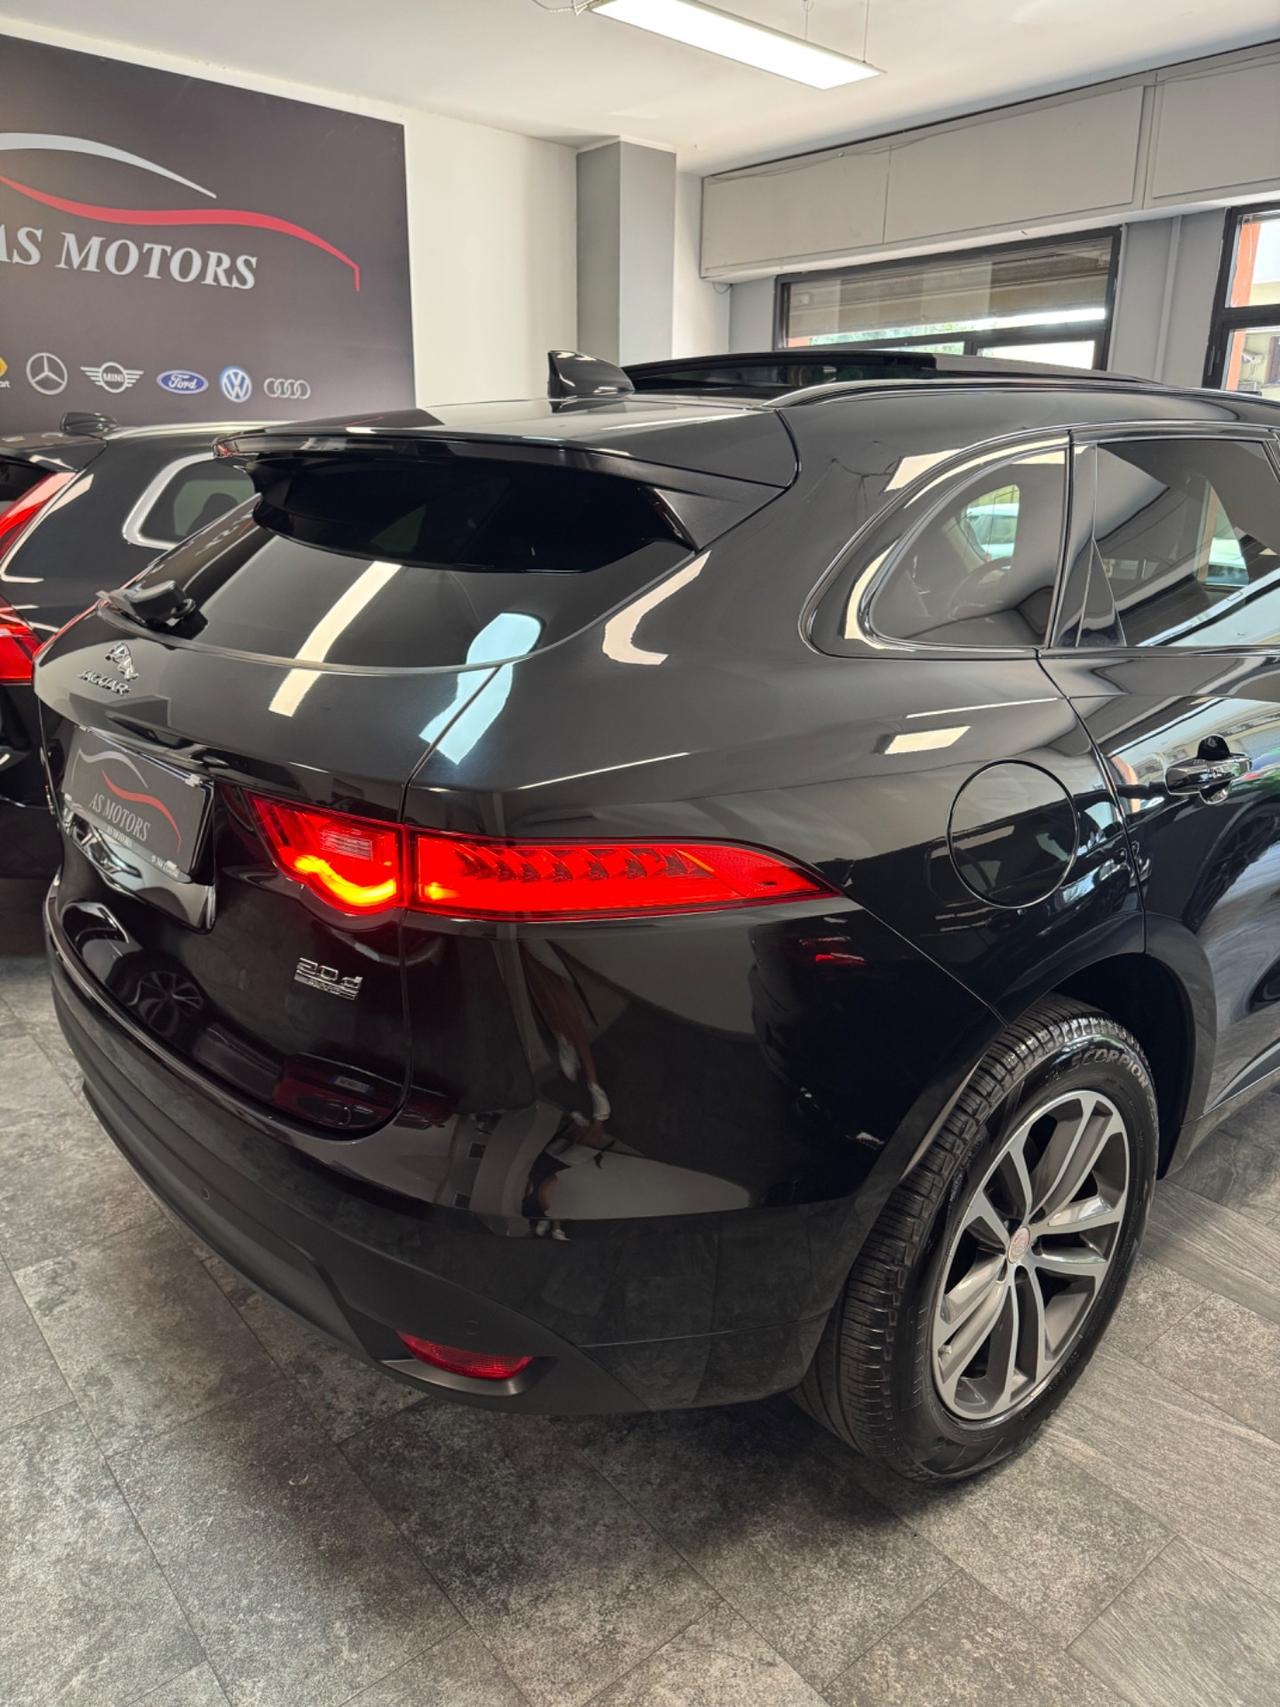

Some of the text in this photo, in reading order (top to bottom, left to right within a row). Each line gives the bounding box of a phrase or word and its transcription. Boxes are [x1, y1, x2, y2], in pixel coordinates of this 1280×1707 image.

[55, 231, 257, 290] MOTORS
[168, 374, 197, 389] Ford
[77, 670, 131, 695] JAGUAR
[89, 792, 105, 813] AS
[103, 799, 151, 842] MOTORS
[1069, 1048, 1150, 1089] SCORPION
